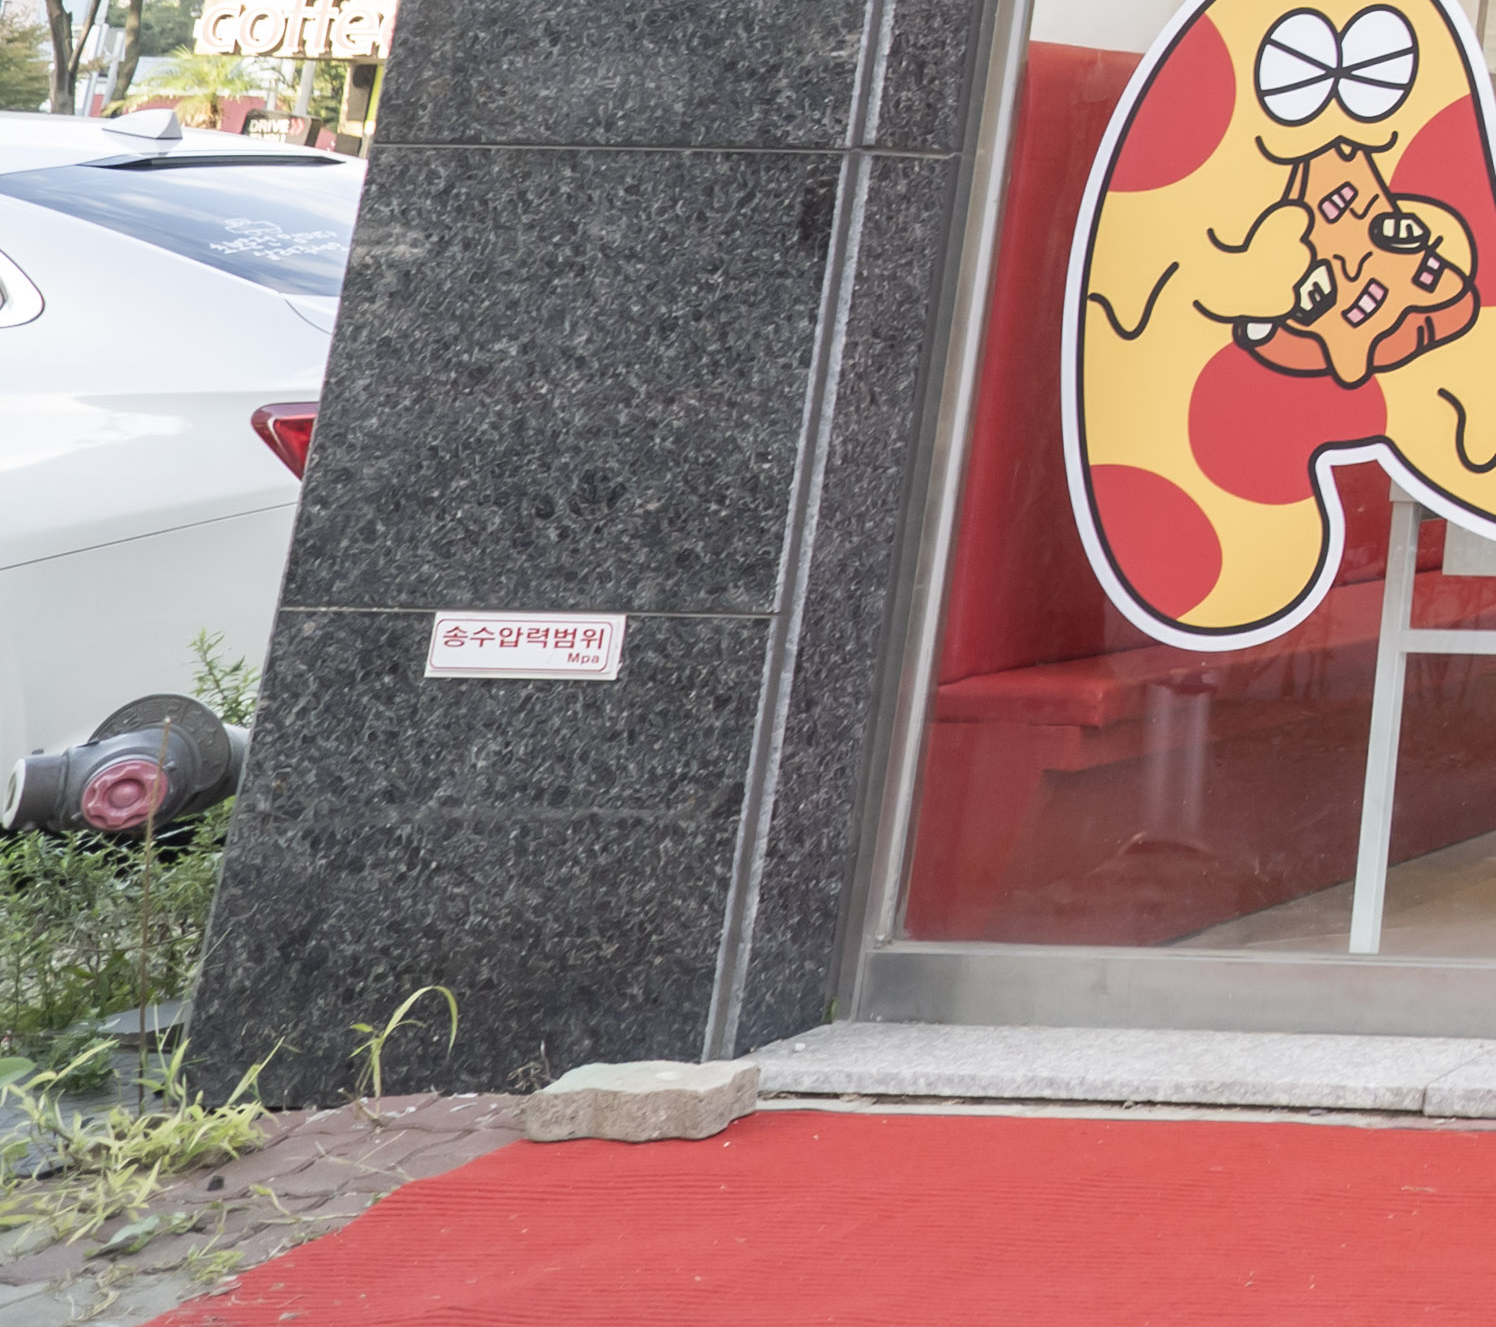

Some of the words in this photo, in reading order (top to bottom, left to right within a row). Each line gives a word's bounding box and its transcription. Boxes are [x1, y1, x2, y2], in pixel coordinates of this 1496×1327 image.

[249, 119, 290, 133] DRIVE
[442, 626, 604, 650] 송수압력범위
[567, 652, 599, 665] Mpa
